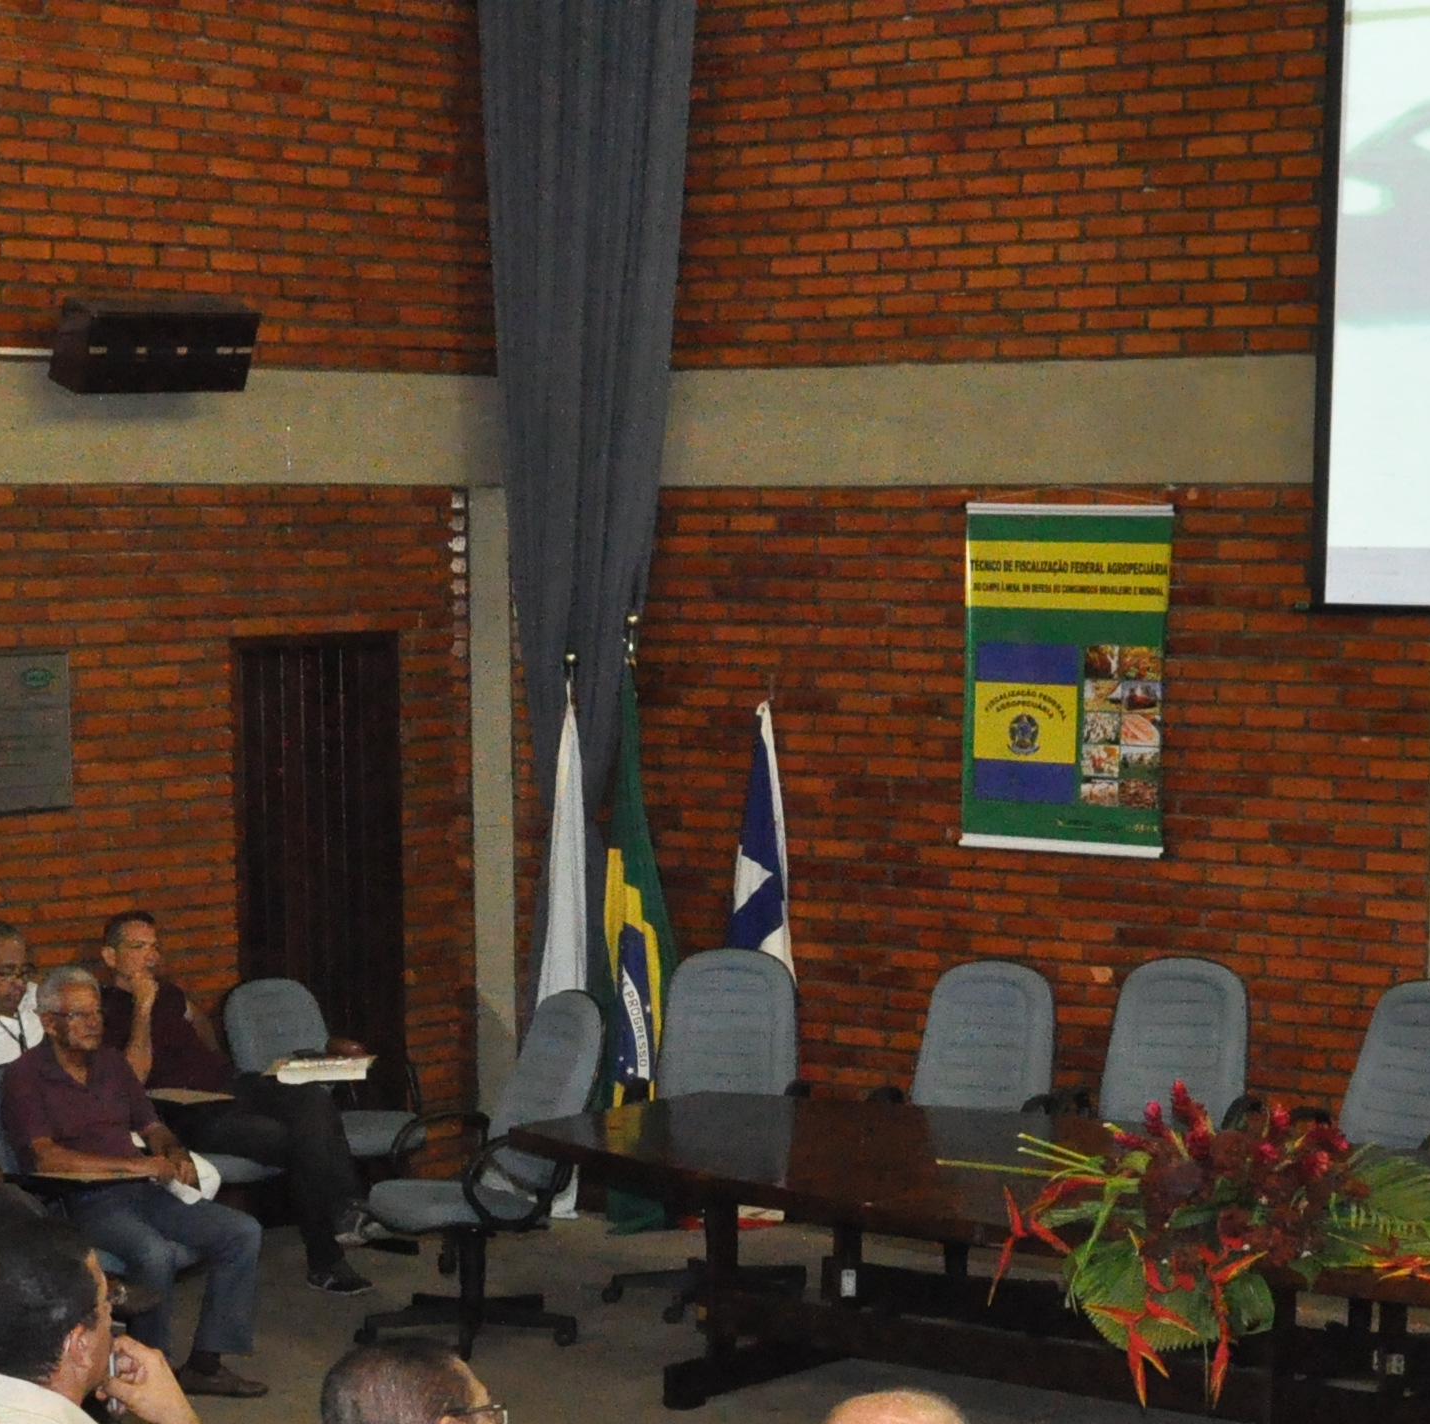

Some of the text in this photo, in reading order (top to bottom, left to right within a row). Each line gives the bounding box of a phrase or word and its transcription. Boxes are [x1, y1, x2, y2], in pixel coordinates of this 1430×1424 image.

[1071, 561, 1104, 574] FEDERAL
[985, 689, 1037, 712] FISCALIZAÇÃO
[996, 700, 1054, 719] AGROPECUÁRIA
[624, 990, 648, 1068] PROGRESSO
